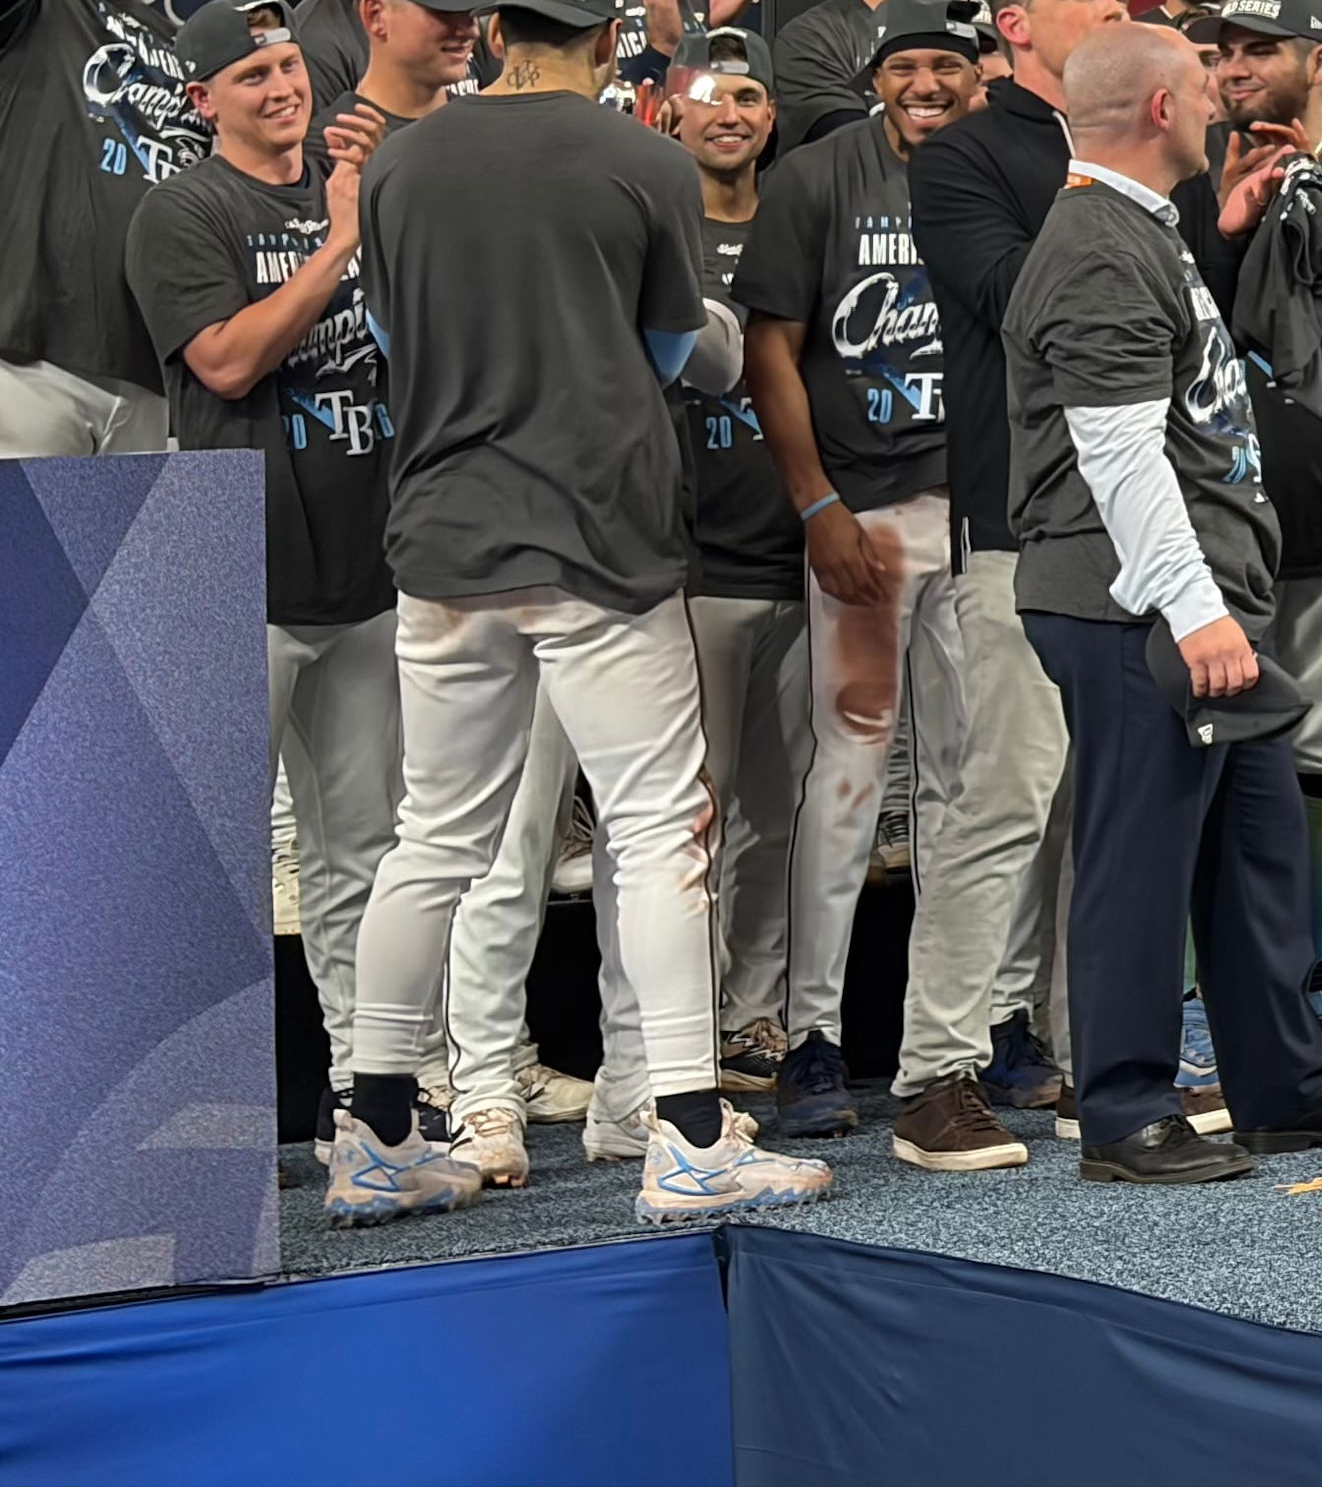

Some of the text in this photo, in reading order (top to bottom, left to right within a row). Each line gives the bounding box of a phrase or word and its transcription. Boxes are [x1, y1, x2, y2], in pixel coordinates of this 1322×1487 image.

[1240, 0, 1282, 19] SERIES
[102, 138, 128, 175] 20
[256, 251, 303, 283] AMER
[315, 390, 375, 456] TB
[867, 388, 893, 424] 20
[706, 416, 733, 450] 20
